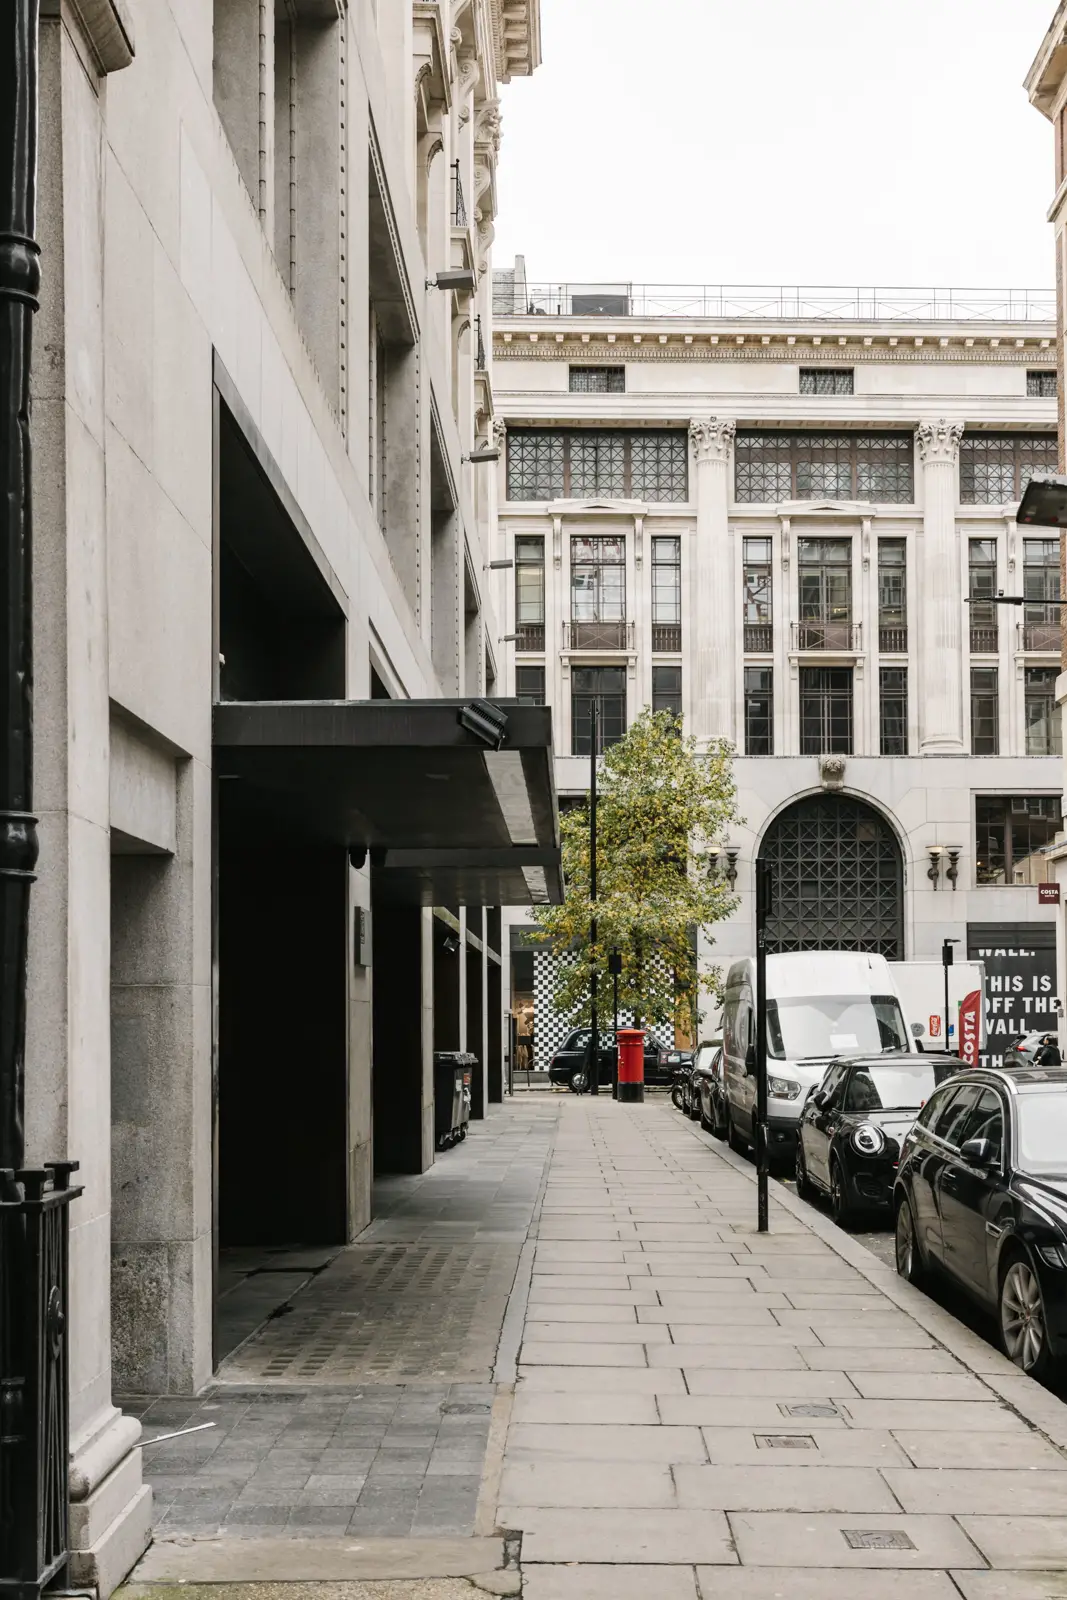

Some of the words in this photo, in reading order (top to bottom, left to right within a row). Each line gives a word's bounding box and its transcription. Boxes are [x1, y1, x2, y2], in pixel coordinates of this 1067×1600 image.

[985, 975, 1024, 992] HIS
[1032, 975, 1052, 992] IS
[1022, 997, 1058, 1013] THE
[962, 1010, 976, 1065] COSTA
